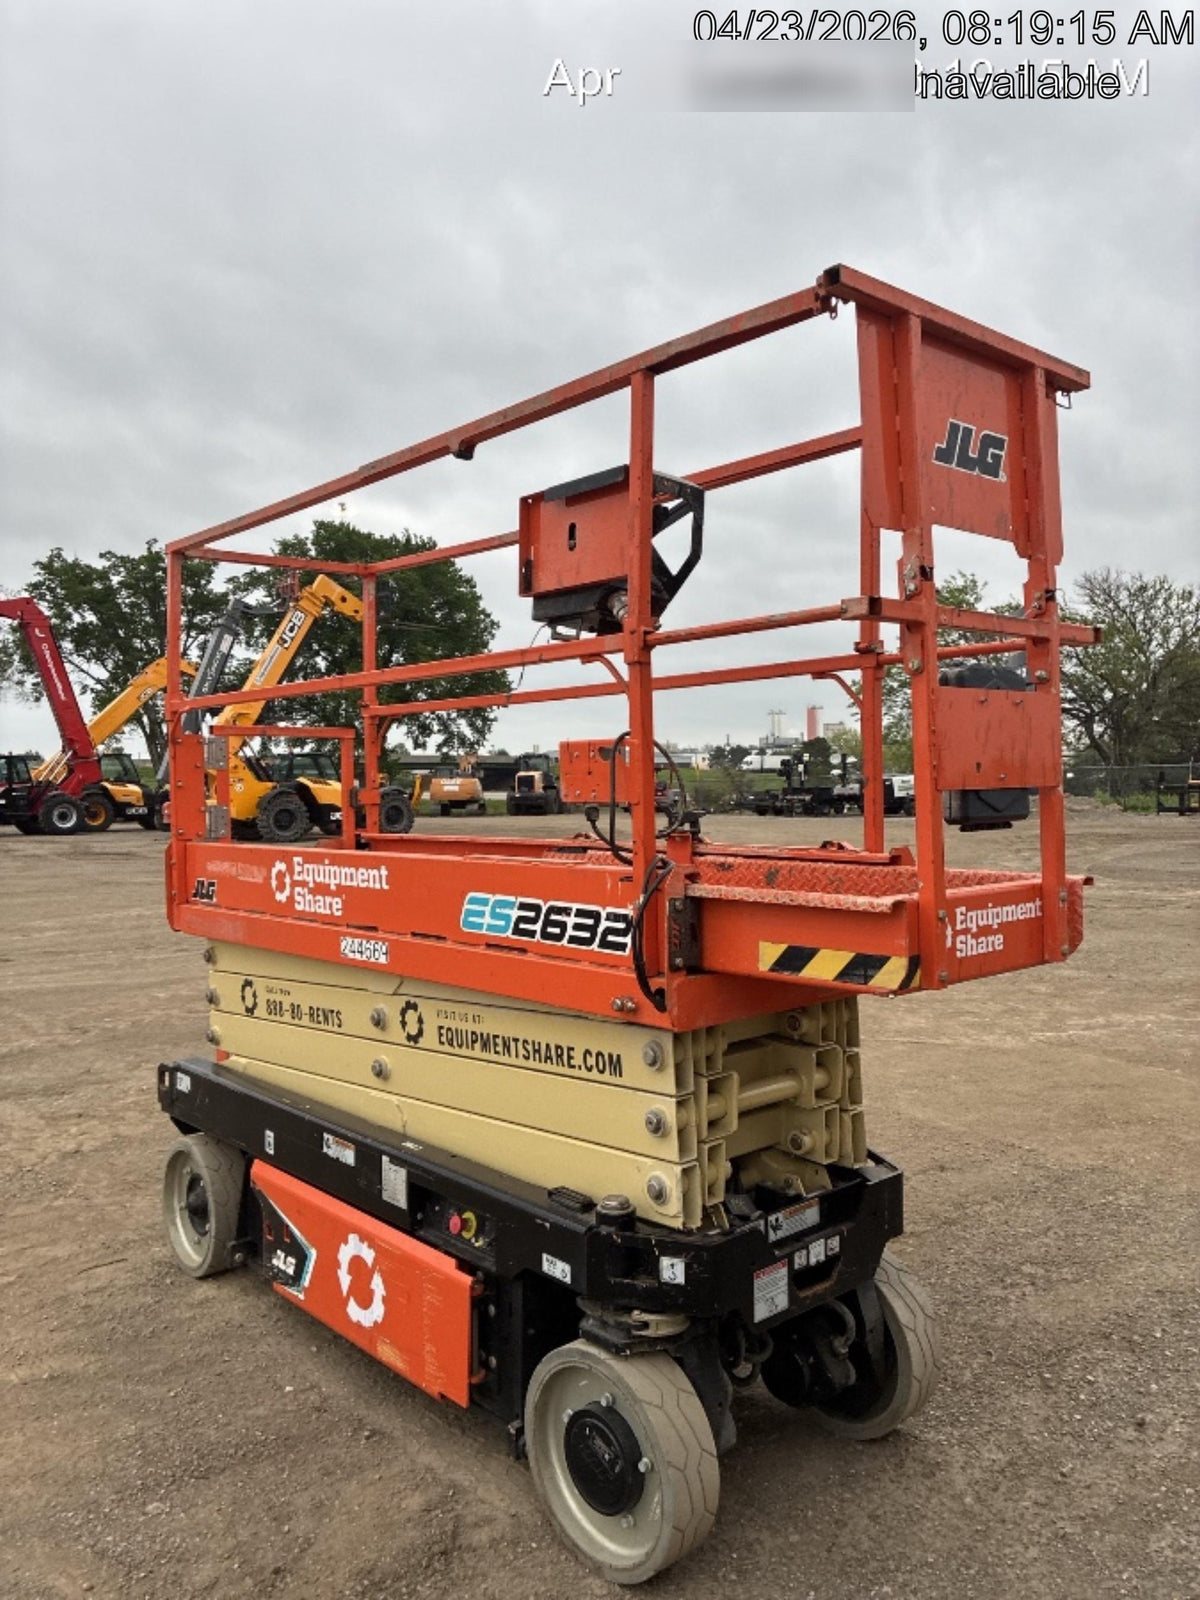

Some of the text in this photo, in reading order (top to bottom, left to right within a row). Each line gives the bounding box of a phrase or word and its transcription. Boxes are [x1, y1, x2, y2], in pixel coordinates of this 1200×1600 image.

[931, 418, 1008, 482] JLG
[281, 609, 306, 649] JCB
[192, 877, 218, 903] JLG
[292, 856, 390, 891] Equipment
[294, 886, 343, 917] Share
[955, 898, 1043, 933] Equipment
[460, 891, 634, 957] ES2632
[956, 932, 1004, 958] Share
[265, 998, 343, 1029] 888-80-RENTS
[437, 1025, 624, 1079] EQUIPMENTSHARE.COM
[271, 1249, 297, 1275] JLG
